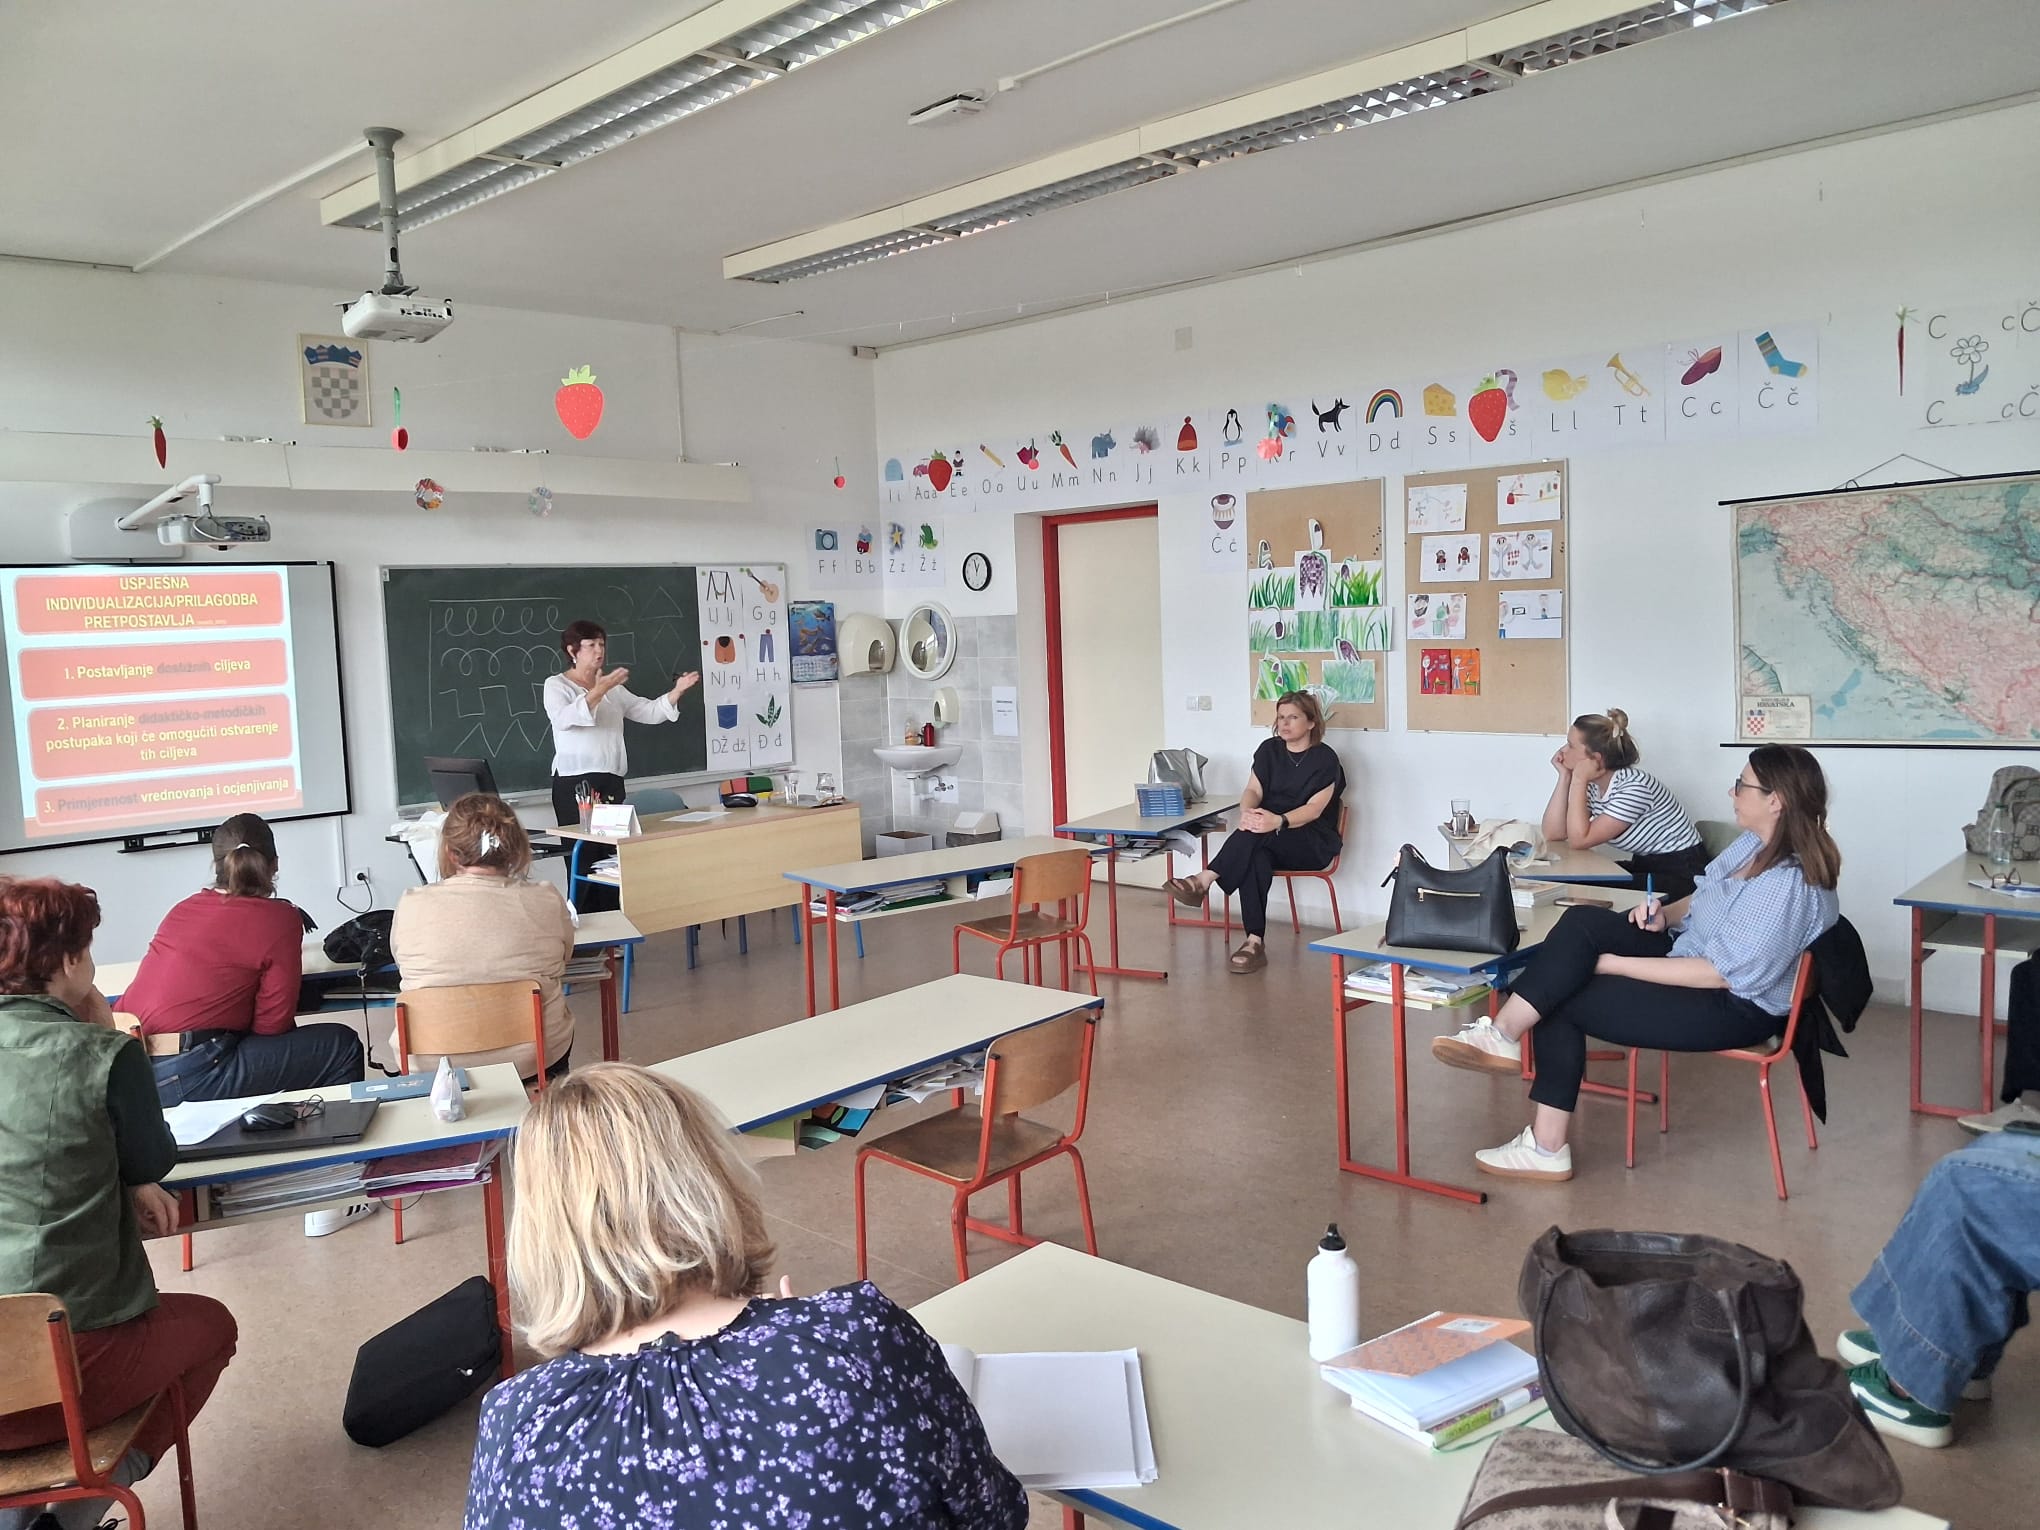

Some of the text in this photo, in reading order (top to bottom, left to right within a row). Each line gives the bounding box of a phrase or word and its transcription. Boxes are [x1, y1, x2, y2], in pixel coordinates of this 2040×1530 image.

[1928, 315, 2015, 339] C c
[1758, 381, 1799, 409] Č č
[2019, 385, 2040, 417] Č
[1613, 405, 1647, 425] T t
[1682, 396, 1721, 417] C c
[1926, 400, 1945, 425] C
[1551, 412, 1560, 432] L
[1369, 431, 1400, 452] D d
[1427, 426, 1456, 445] S s
[1289, 450, 1296, 461] r
[1317, 440, 1344, 458] V v
[1176, 456, 1200, 474] K k
[1221, 452, 1247, 474] P p
[1018, 475, 1038, 491] U u
[1052, 472, 1079, 488] M m
[1093, 467, 1116, 483] N n
[951, 483, 968, 497] E e
[982, 479, 991, 494] O
[1212, 532, 1222, 553] Ć
[819, 560, 824, 574] F
[856, 560, 875, 573] B b
[890, 559, 895, 572] Z
[920, 554, 926, 571] Ž
[119, 575, 189, 591] USPJEŠNA
[45, 593, 258, 611] INDIVIDUALIZACIJA/PRILAGODBA
[84, 613, 195, 629] PRETPOSTAVLJA
[752, 606, 763, 620] G
[769, 610, 776, 625] g
[64, 668, 75, 680] 1.
[77, 662, 153, 679] Postavljanje
[214, 658, 251, 673] ciljeva
[756, 667, 766, 682] H
[774, 668, 781, 681] h
[711, 671, 741, 688] NJ nj
[56, 718, 69, 731] 2.
[72, 714, 135, 732] Planiranje
[46, 722, 279, 752] postupaka koji će omogućiti ostvarenje
[712, 735, 729, 754] DŽ
[140, 746, 197, 761] tih ciljeva
[44, 800, 55, 814] 3.
[140, 786, 214, 803] vrednovanja
[222, 777, 289, 796] ocjenjivanja
